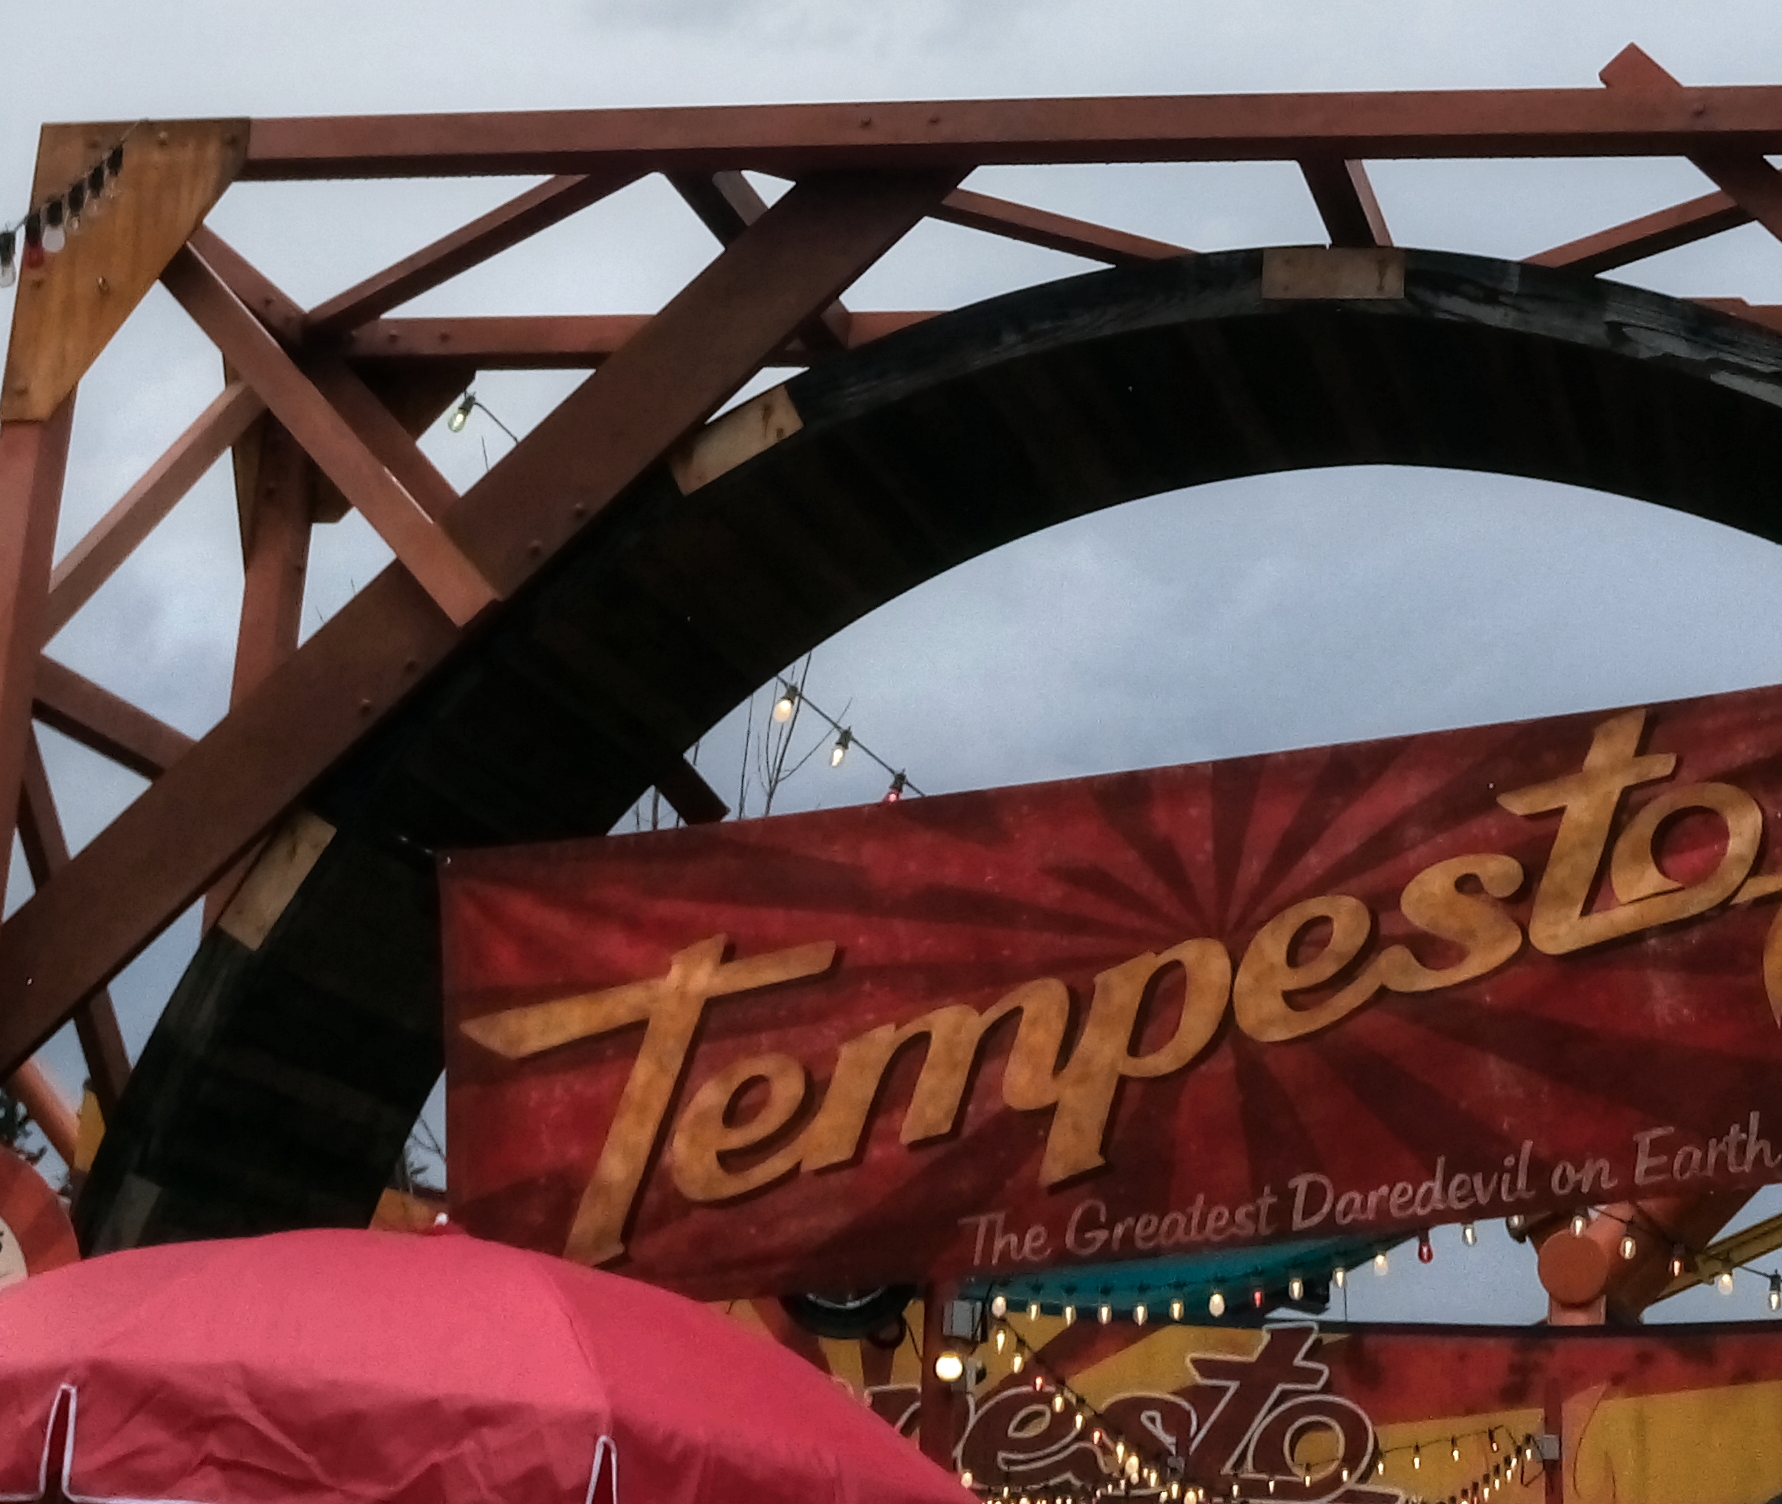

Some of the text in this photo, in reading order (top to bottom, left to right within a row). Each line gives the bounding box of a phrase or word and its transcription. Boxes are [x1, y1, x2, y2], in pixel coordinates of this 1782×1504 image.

[958, 1207, 1053, 1267] The
[1064, 1184, 1279, 1257] Greatest
[1287, 1139, 1535, 1234] Daredevil
[1550, 1154, 1619, 1197] on
